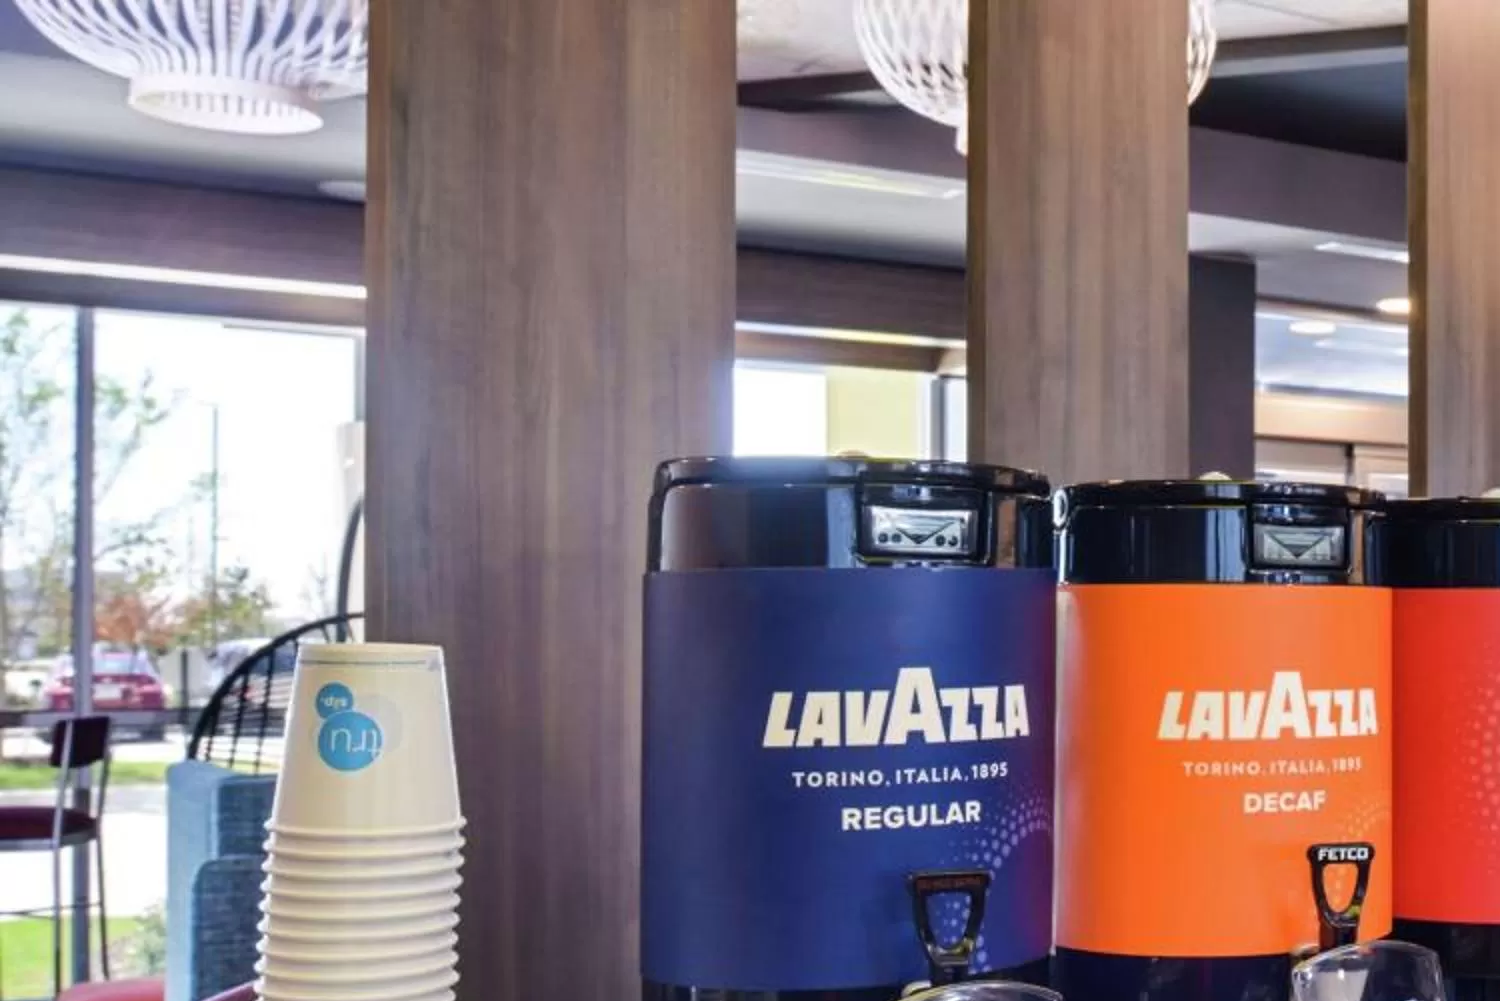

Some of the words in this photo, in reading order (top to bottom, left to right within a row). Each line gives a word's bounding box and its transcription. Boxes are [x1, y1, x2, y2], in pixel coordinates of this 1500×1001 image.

[762, 667, 1030, 747] LAVAZZA
[1157, 671, 1378, 740] LAVAZZA
[971, 762, 1008, 781] 1895
[1243, 790, 1326, 813] DECAF
[841, 800, 981, 831] REGULAR
[1317, 847, 1369, 861] FETCO
